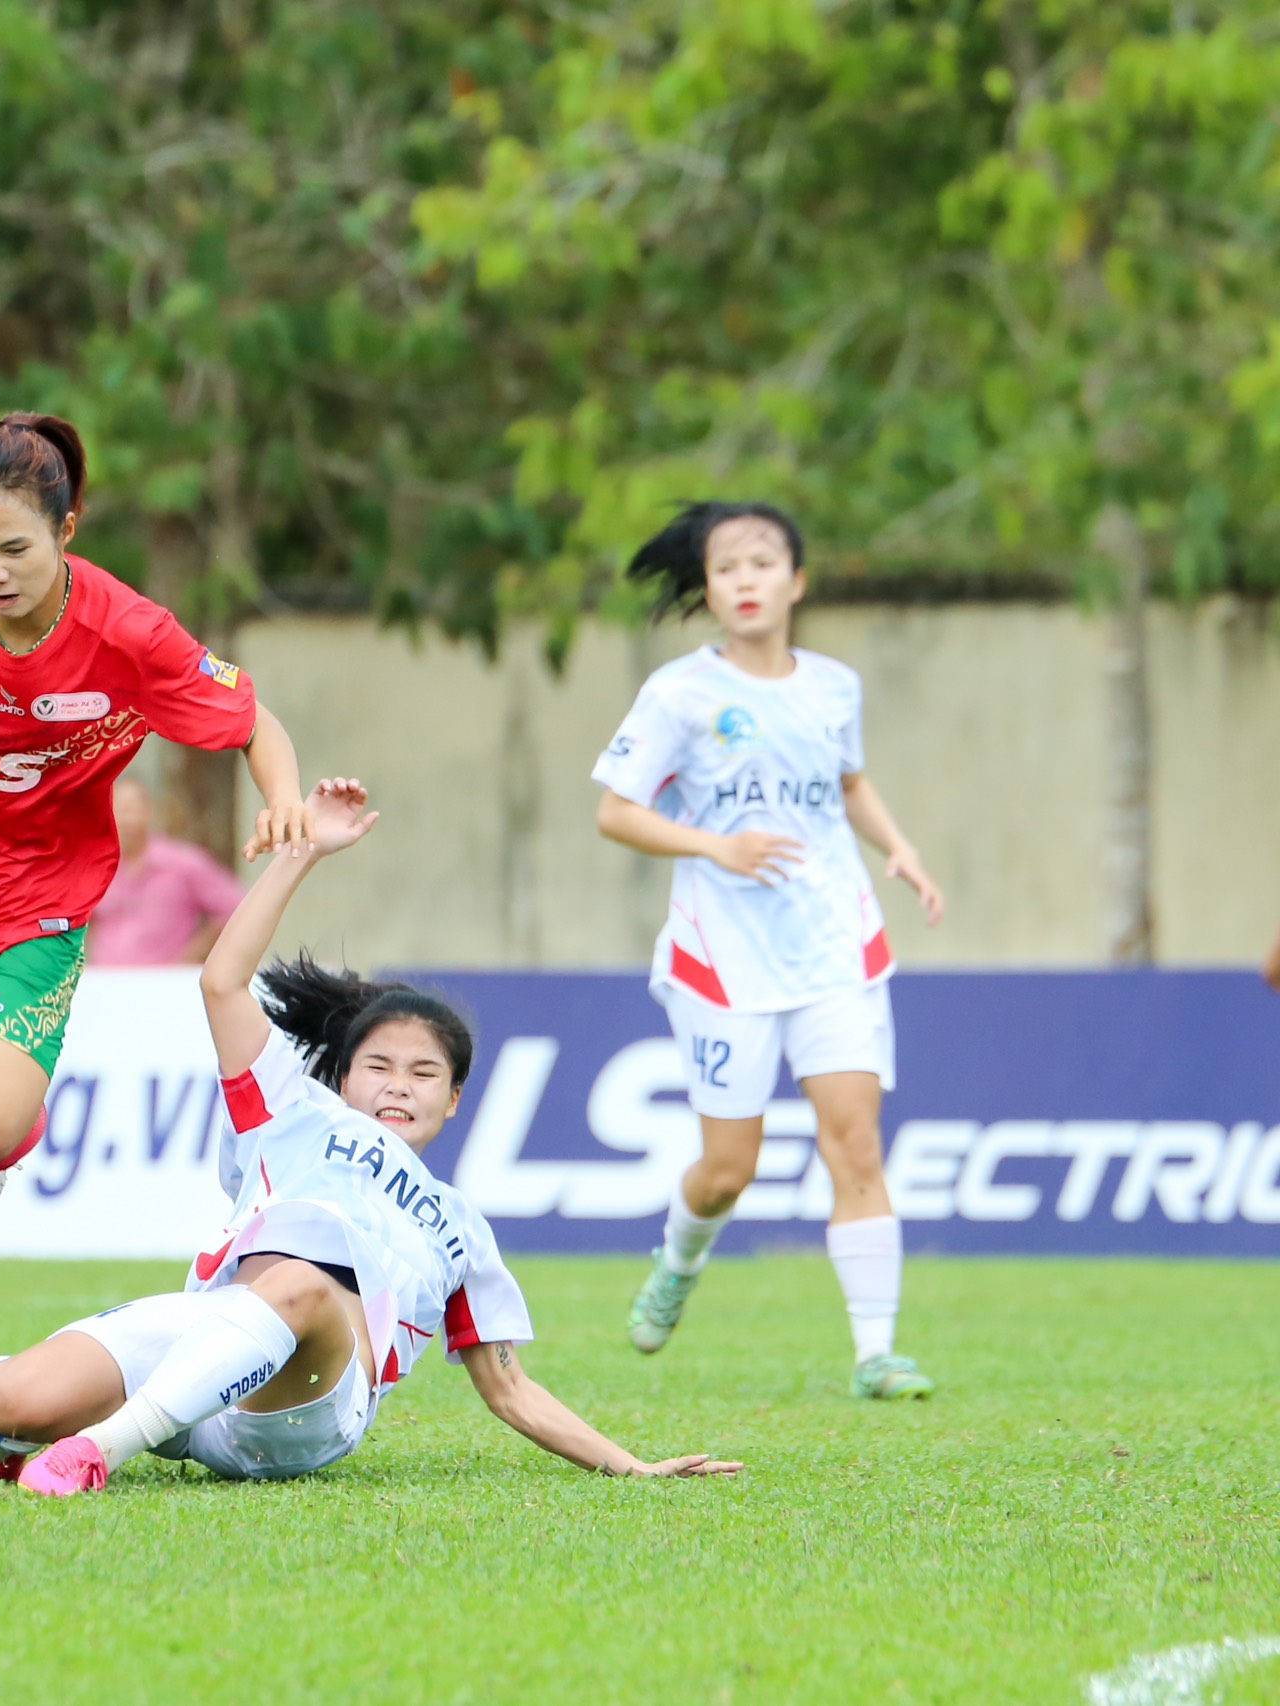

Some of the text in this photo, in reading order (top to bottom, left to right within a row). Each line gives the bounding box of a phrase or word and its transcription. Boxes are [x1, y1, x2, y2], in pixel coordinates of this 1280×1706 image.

[692, 1035, 731, 1088] 42
[324, 1133, 386, 1180] HÀ
[383, 1167, 449, 1236] NỘI
